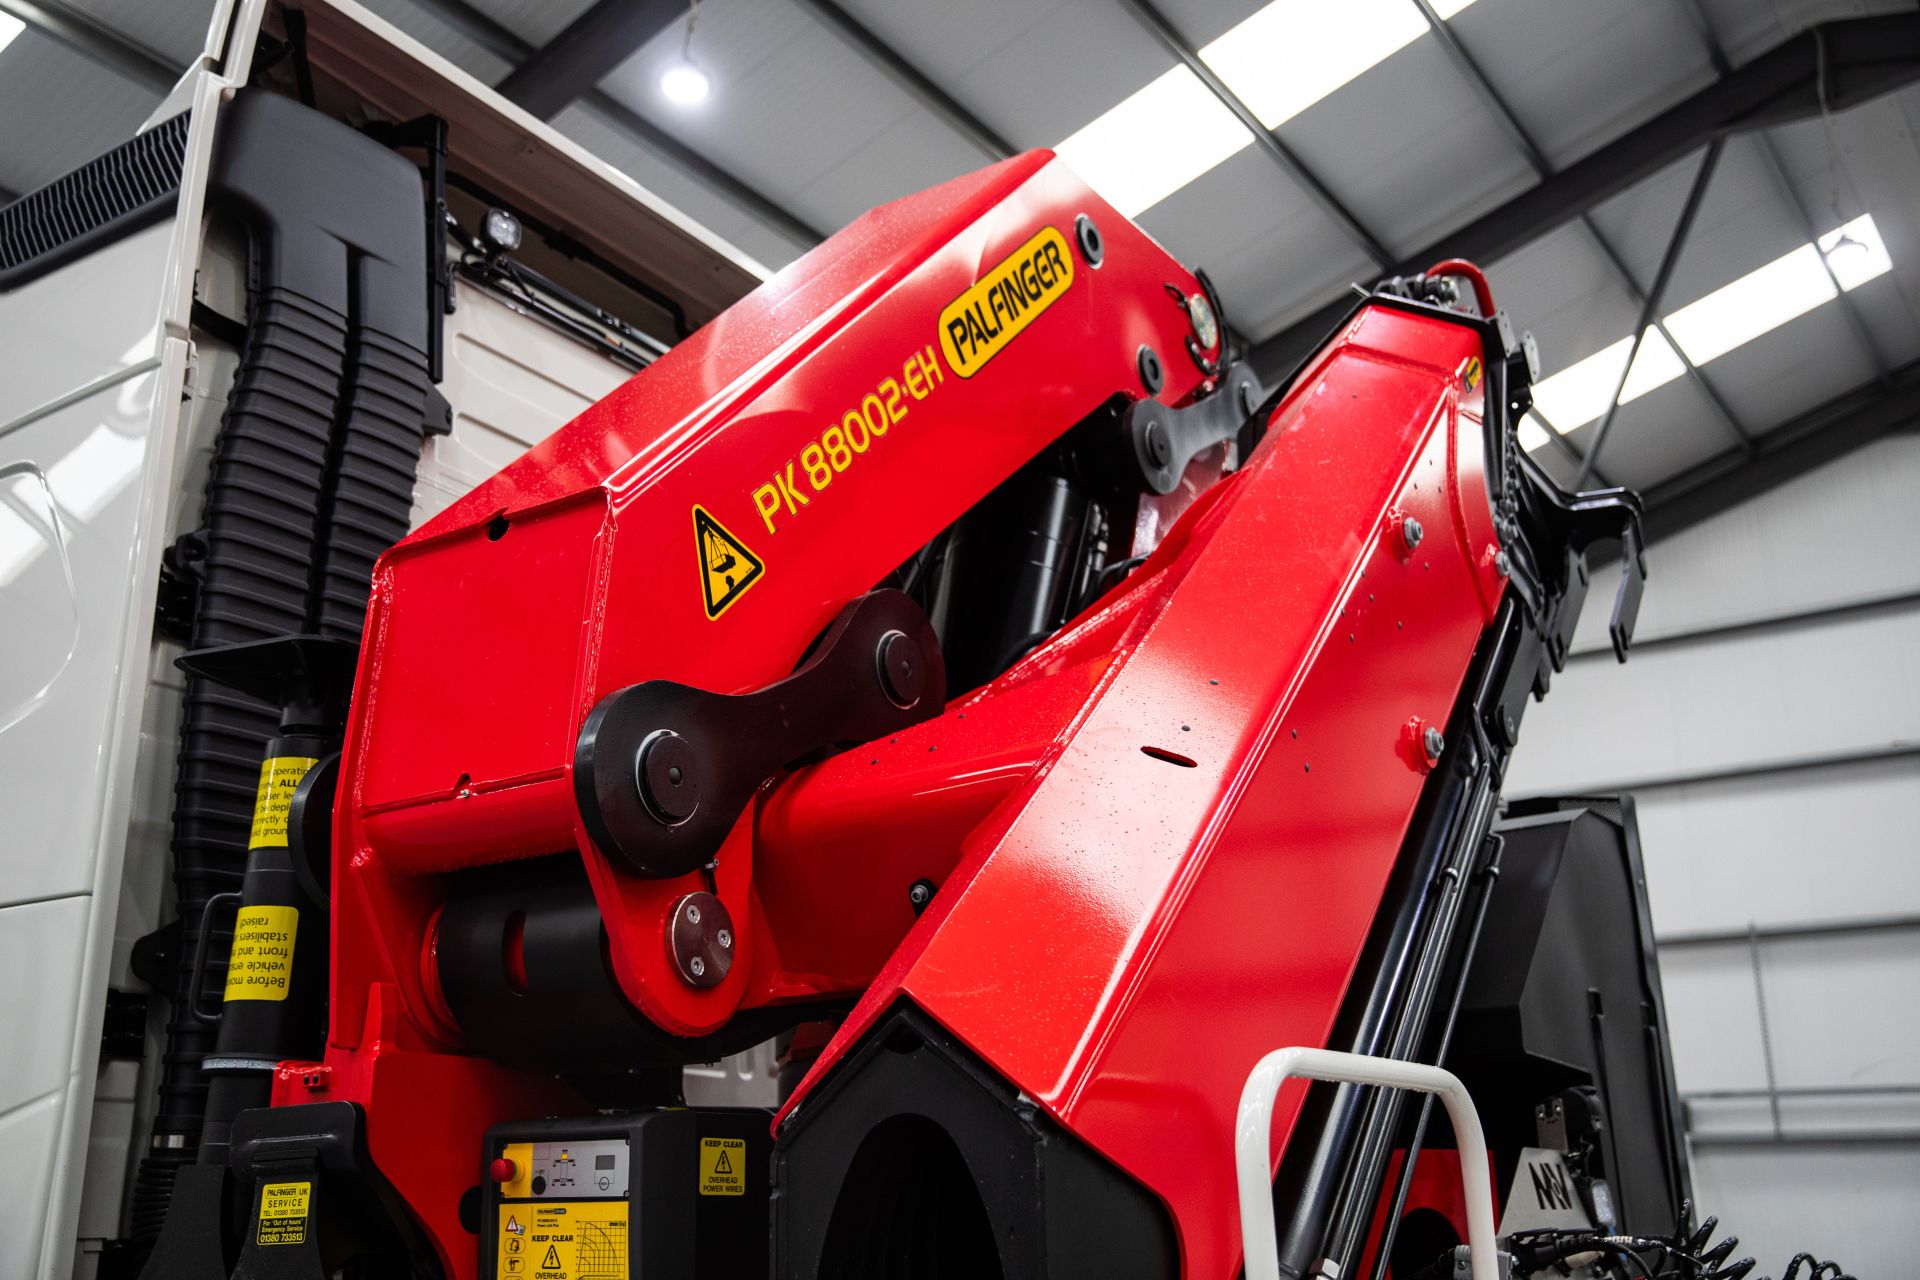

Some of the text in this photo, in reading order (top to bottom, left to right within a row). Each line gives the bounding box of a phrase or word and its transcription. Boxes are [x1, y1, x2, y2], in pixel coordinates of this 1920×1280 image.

[946, 239, 1068, 366] PALFINGER
[751, 461, 810, 536] PK
[272, 766, 309, 776] operatin
[279, 779, 299, 787] ALL
[270, 802, 290, 813] depl
[239, 932, 288, 943] stabilisers
[238, 946, 254, 958] and
[258, 946, 288, 959] front
[247, 961, 285, 972] vehicle
[246, 976, 285, 988] Before
[708, 1176, 738, 1184] OVERHEAD
[266, 1188, 297, 1197] PALFINGER
[703, 1184, 743, 1193] POWER WIRES
[268, 1198, 303, 1208] SERVICE
[260, 1232, 303, 1243] 01380 733513
[531, 1234, 574, 1242] KEEP CLEAR
[534, 1272, 568, 1280] OVERHEAD
